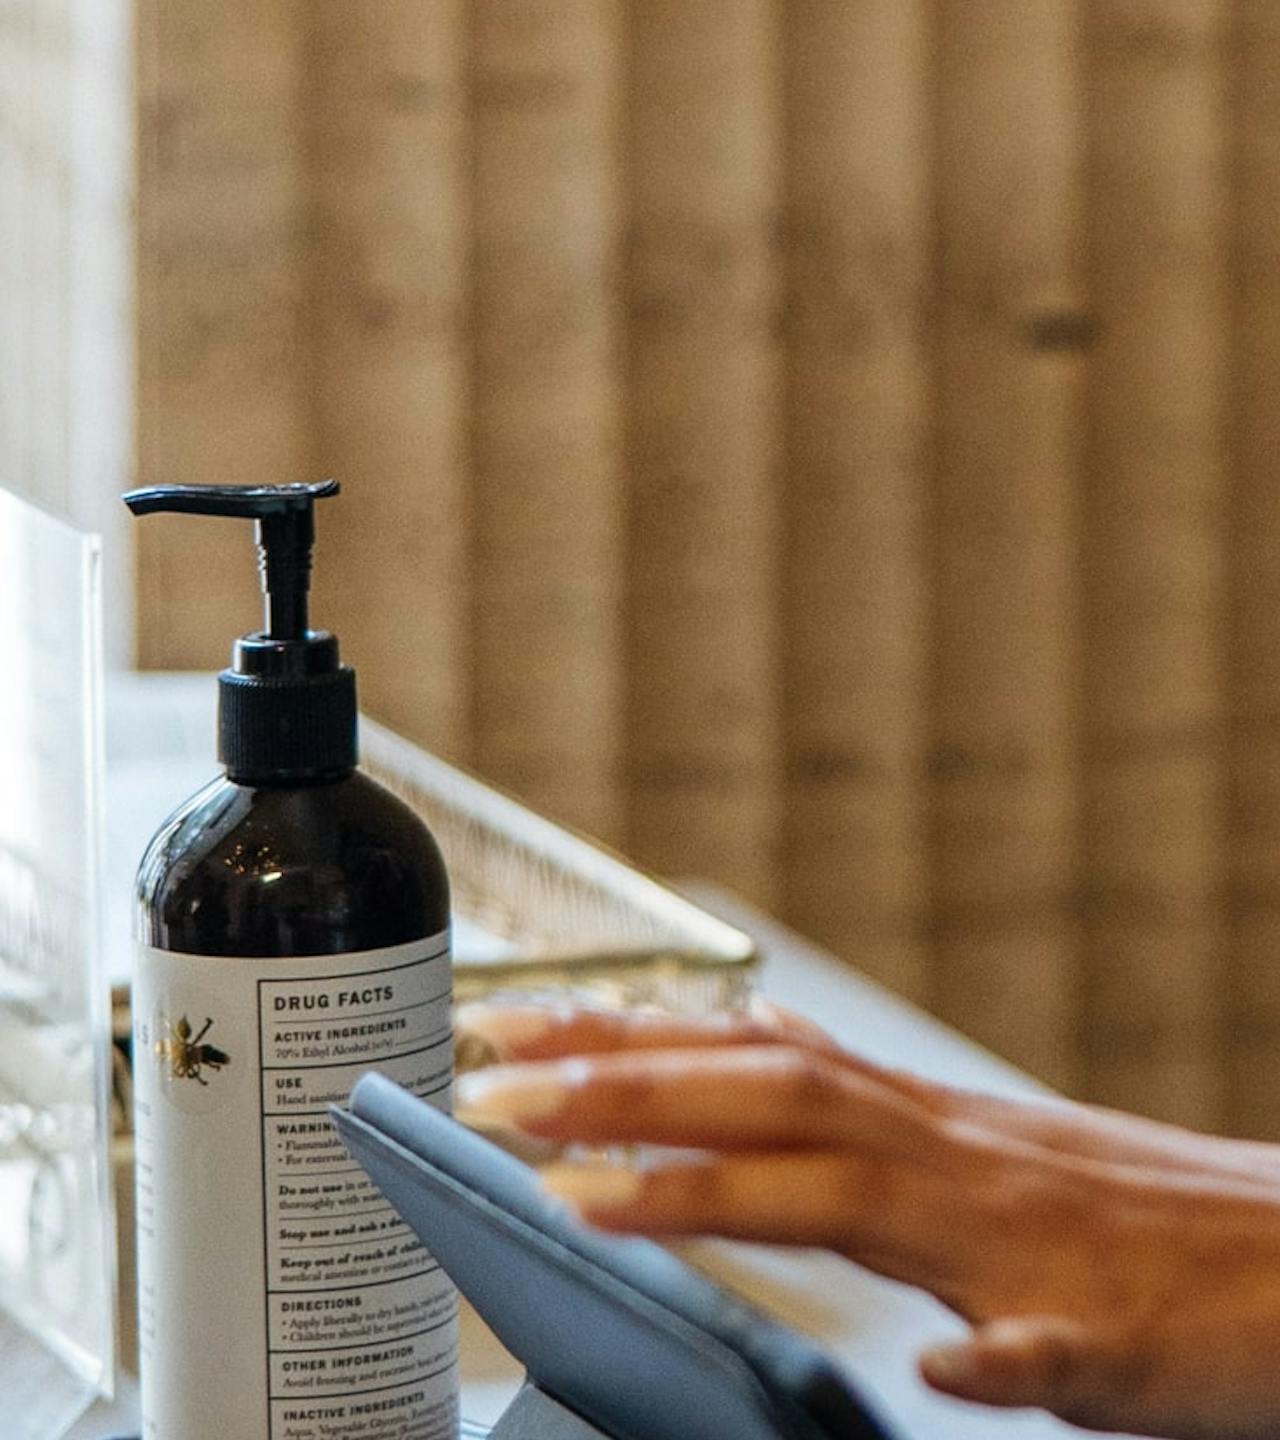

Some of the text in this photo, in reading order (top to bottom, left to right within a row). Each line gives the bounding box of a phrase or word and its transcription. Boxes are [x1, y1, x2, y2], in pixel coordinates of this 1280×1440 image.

[274, 986, 394, 1012] DRUG FACTS
[274, 1019, 406, 1043] ACTIVE INGREDIENTS
[332, 1040, 370, 1056] Alcohol
[275, 1078, 302, 1089] USE
[276, 1094, 306, 1105] Hand
[277, 1122, 337, 1134] WARNIN
[285, 1154, 302, 1166] For
[278, 1185, 296, 1196] Do
[300, 1185, 319, 1195] not
[322, 1184, 342, 1193] use
[279, 1228, 306, 1241] Stop
[310, 1229, 330, 1238] use
[334, 1224, 355, 1236] and
[358, 1221, 377, 1232] ask
[280, 1257, 311, 1270] Keep
[315, 1257, 334, 1266] out
[337, 1253, 351, 1264] of
[353, 1248, 384, 1262] reach
[281, 1296, 362, 1312] DIRECTIONS
[290, 1331, 336, 1342] Children
[282, 1359, 326, 1372] OTHER
[332, 1345, 414, 1368] INFORMATION
[284, 1407, 345, 1421] INACTIVE
[349, 1391, 424, 1417] INGREDIENTS
